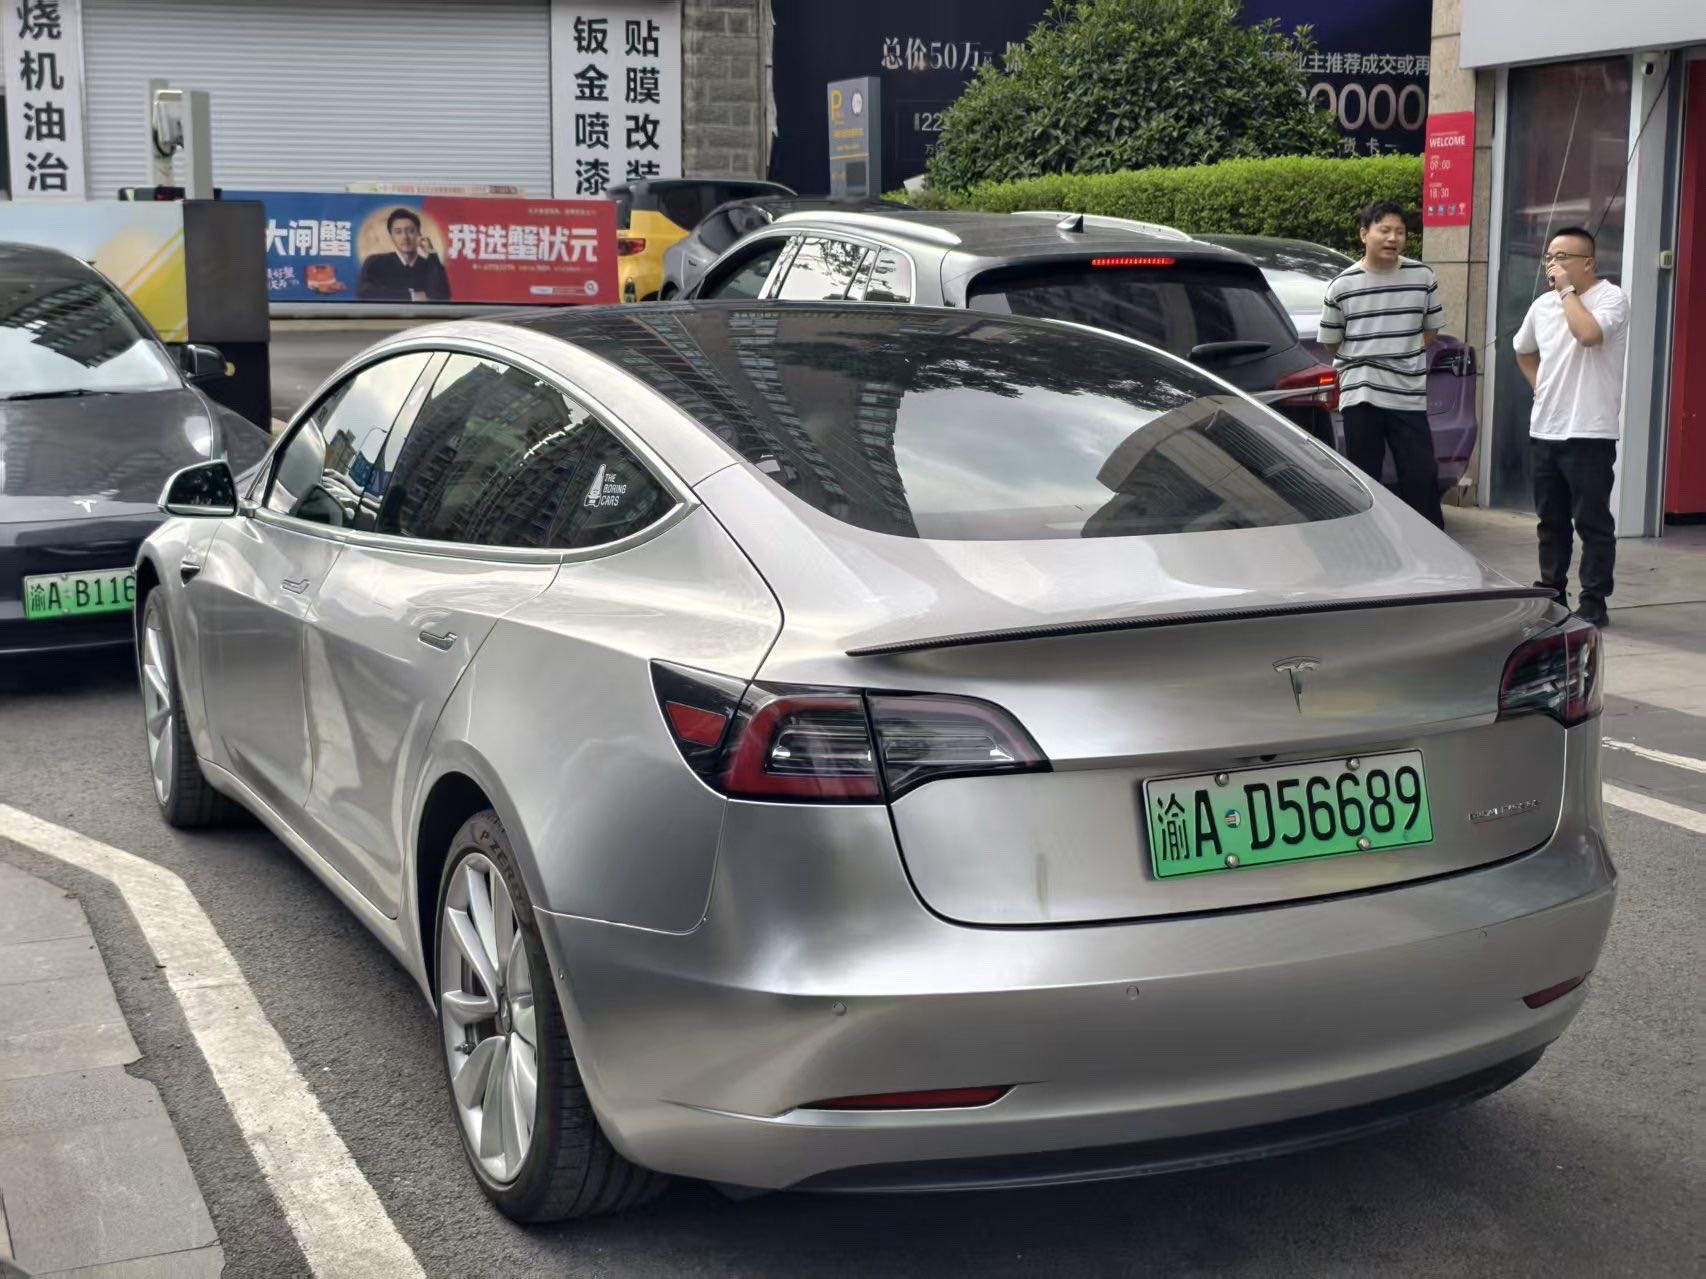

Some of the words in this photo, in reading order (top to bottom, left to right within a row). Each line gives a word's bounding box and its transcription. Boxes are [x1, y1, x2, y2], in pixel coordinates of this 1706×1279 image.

[17, 0, 69, 192] 烧机油治
[573, 16, 610, 196] 钣金喷漆
[1429, 135, 1466, 148] WELCOME
[266, 219, 351, 257] 大闸蟹
[448, 224, 598, 262] 我选蟹状元
[603, 484, 627, 494] BORING
[605, 473, 617, 482] THE
[600, 495, 620, 506] CARS
